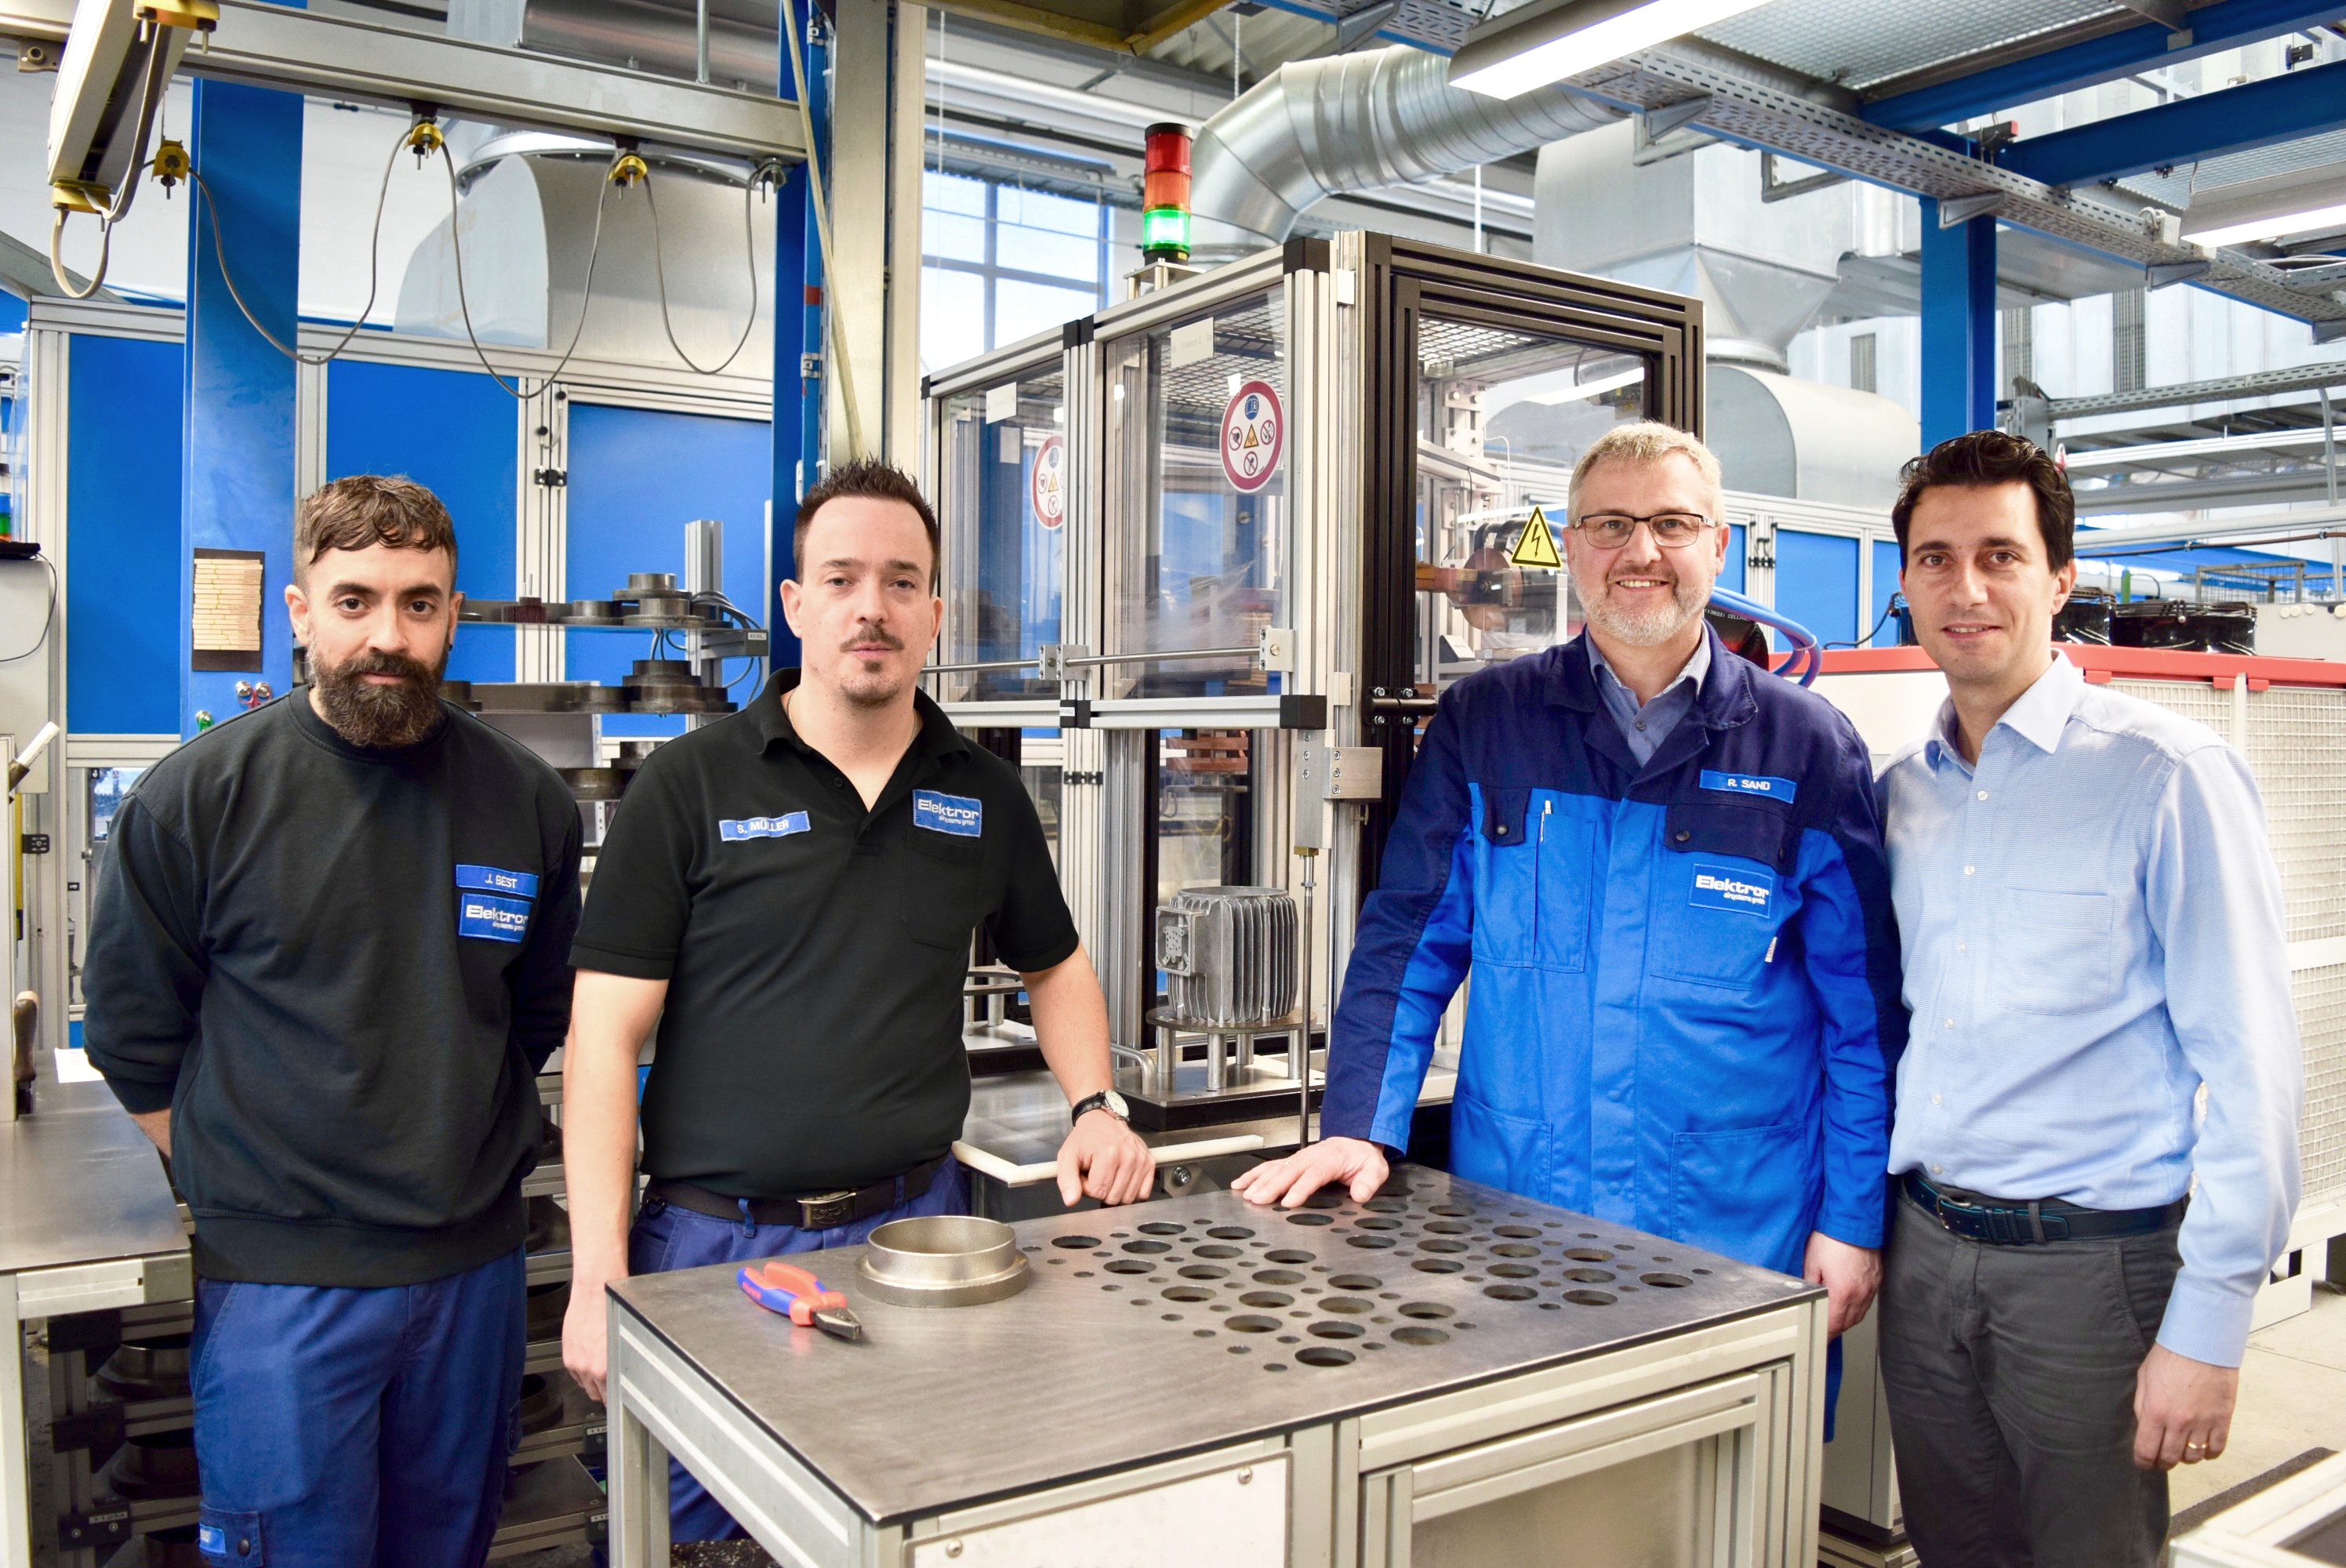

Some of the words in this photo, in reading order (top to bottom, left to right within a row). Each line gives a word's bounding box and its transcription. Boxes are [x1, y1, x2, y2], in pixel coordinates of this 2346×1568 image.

[1727, 779, 1738, 787] R.
[1741, 779, 1770, 791] SAND
[917, 798, 979, 820] Elektror
[737, 824, 748, 834] S.
[485, 873, 493, 884] J.
[496, 874, 518, 889] BEST
[1695, 874, 1770, 898] Elektror
